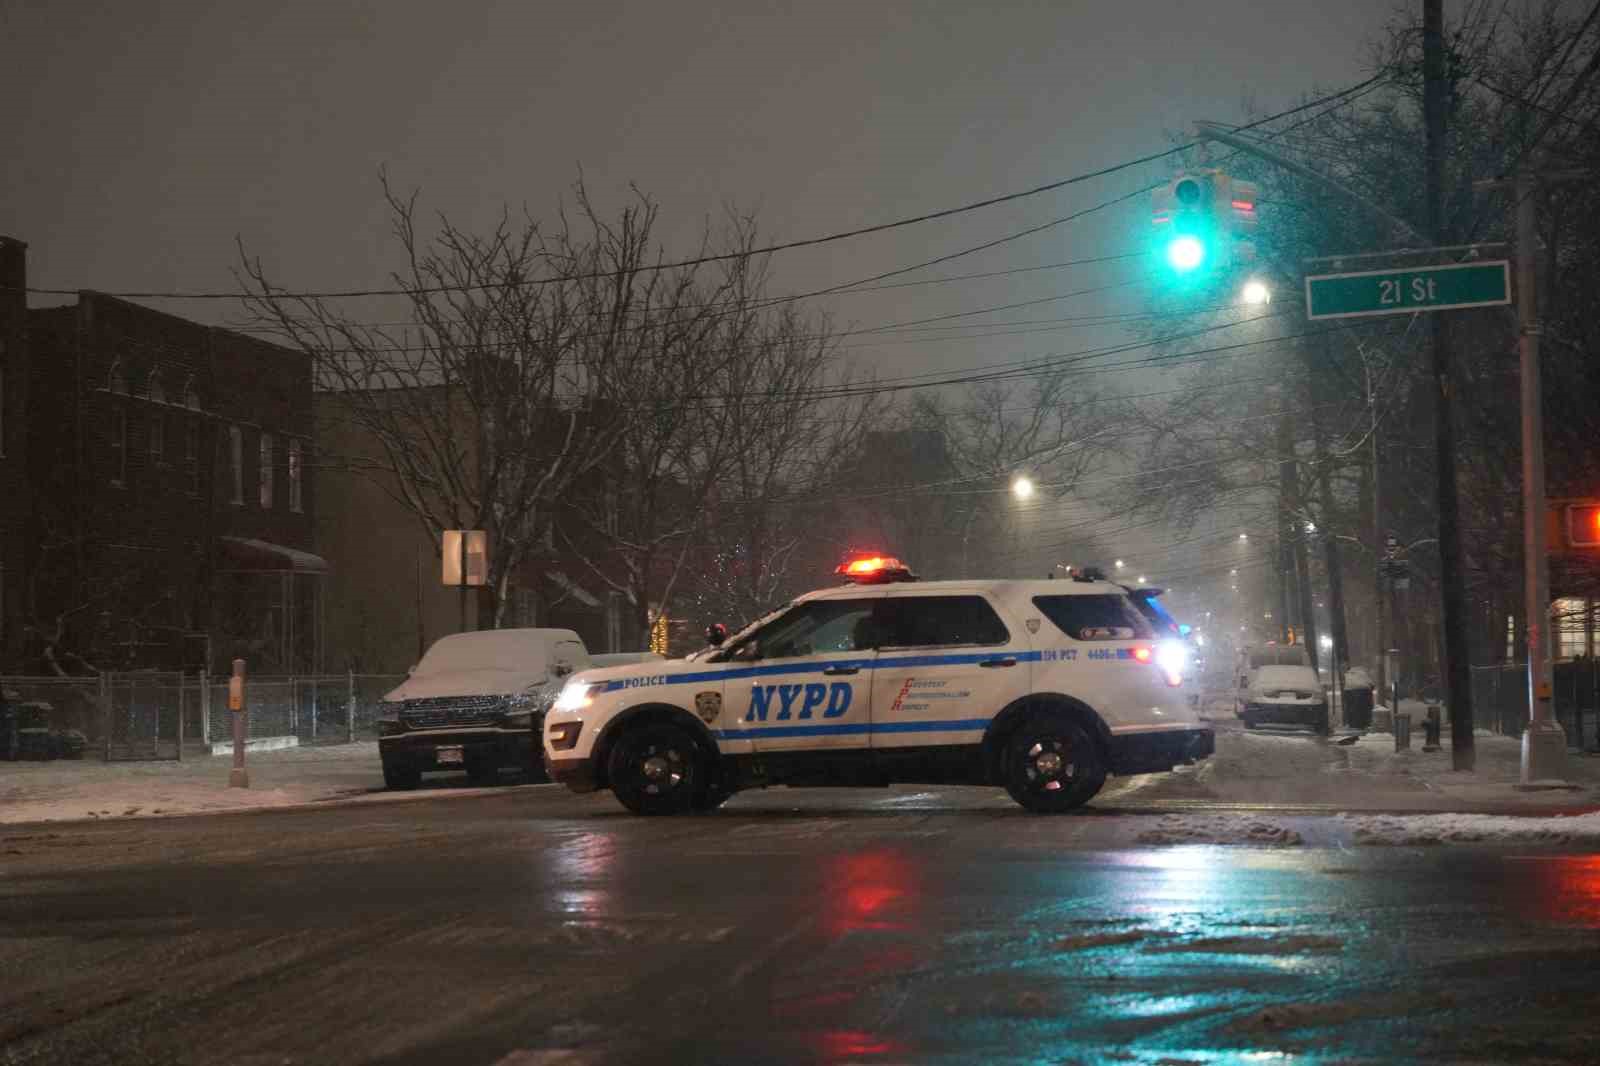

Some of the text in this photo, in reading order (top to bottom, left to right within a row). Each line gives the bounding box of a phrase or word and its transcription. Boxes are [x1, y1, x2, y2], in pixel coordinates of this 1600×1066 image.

[1379, 277, 1436, 304] 21 St
[624, 675, 666, 689] POLICE
[745, 682, 853, 722] NYPD
